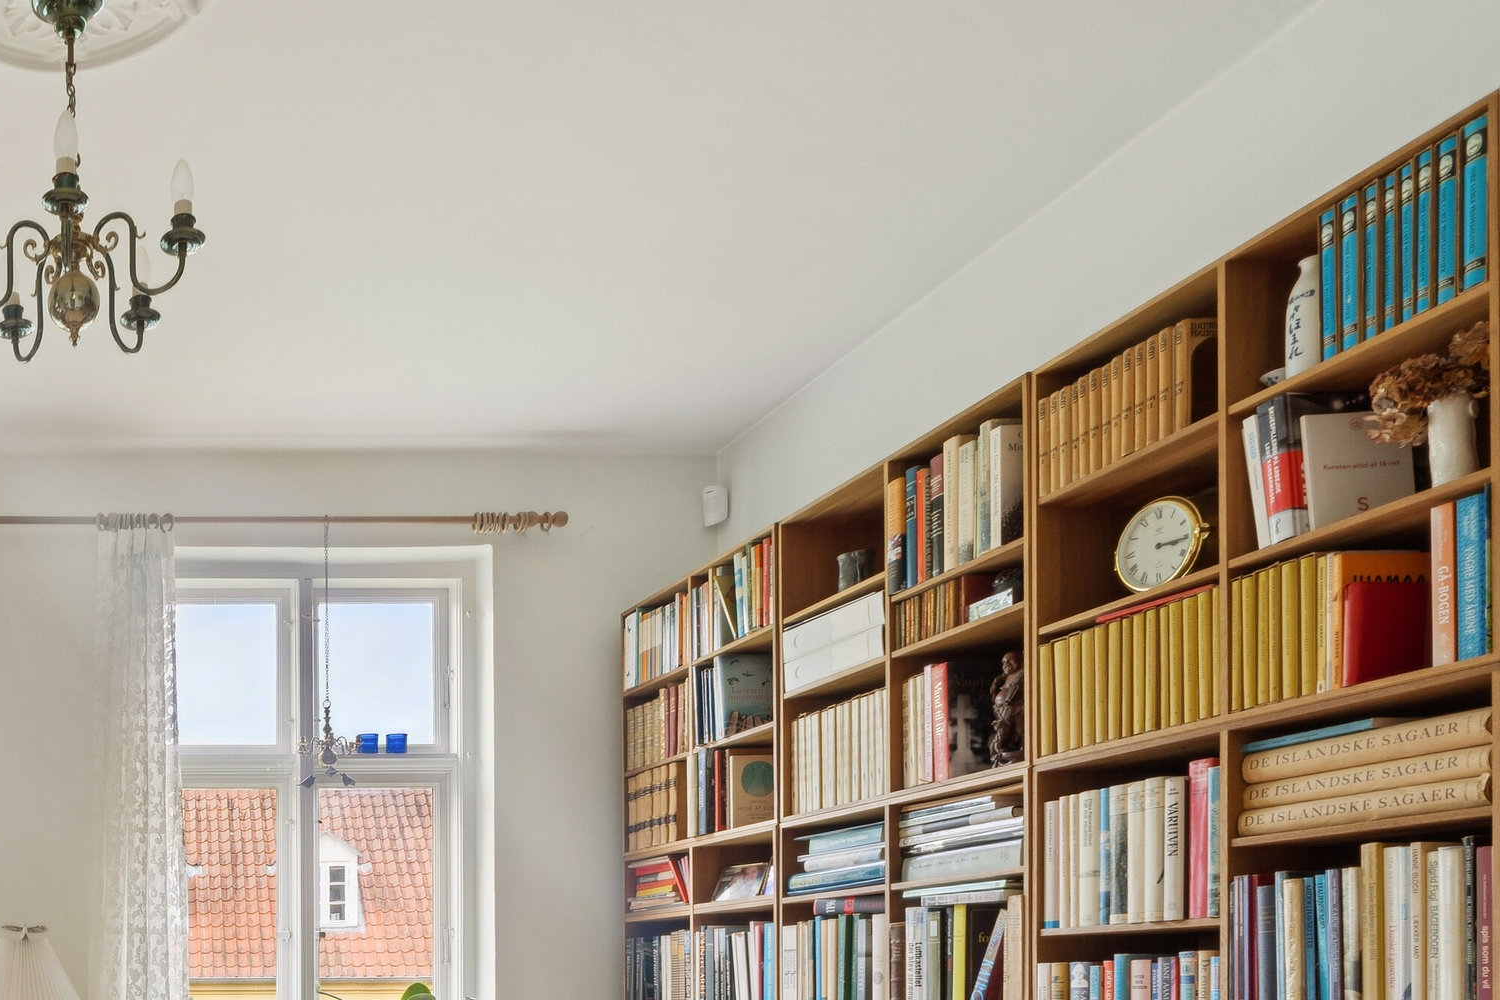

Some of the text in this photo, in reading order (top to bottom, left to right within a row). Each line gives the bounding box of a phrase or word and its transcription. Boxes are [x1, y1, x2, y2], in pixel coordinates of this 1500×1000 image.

[1357, 496, 1370, 511] S
[1464, 546, 1478, 579] YNGRE
[1464, 582, 1477, 604] MED
[1464, 606, 1478, 636] ÅRENE
[934, 682, 943, 720] Vand til
[1250, 720, 1460, 771] DE ISLANDSKE SAGAER
[1249, 756, 1460, 802] DE ISLANDSKE SAGAER
[1244, 787, 1457, 828] DE ISLANDSKE SAGAER
[1168, 802, 1179, 857] VARULVEN
[1429, 861, 1439, 959] Sigrid Fugl BAGEBOGEN
[1480, 925, 1490, 943] spis
[914, 942, 922, 987] Luftkastellet
[1201, 959, 1210, 971] De
[1482, 966, 1490, 977] du
[1482, 978, 1490, 989] vil
